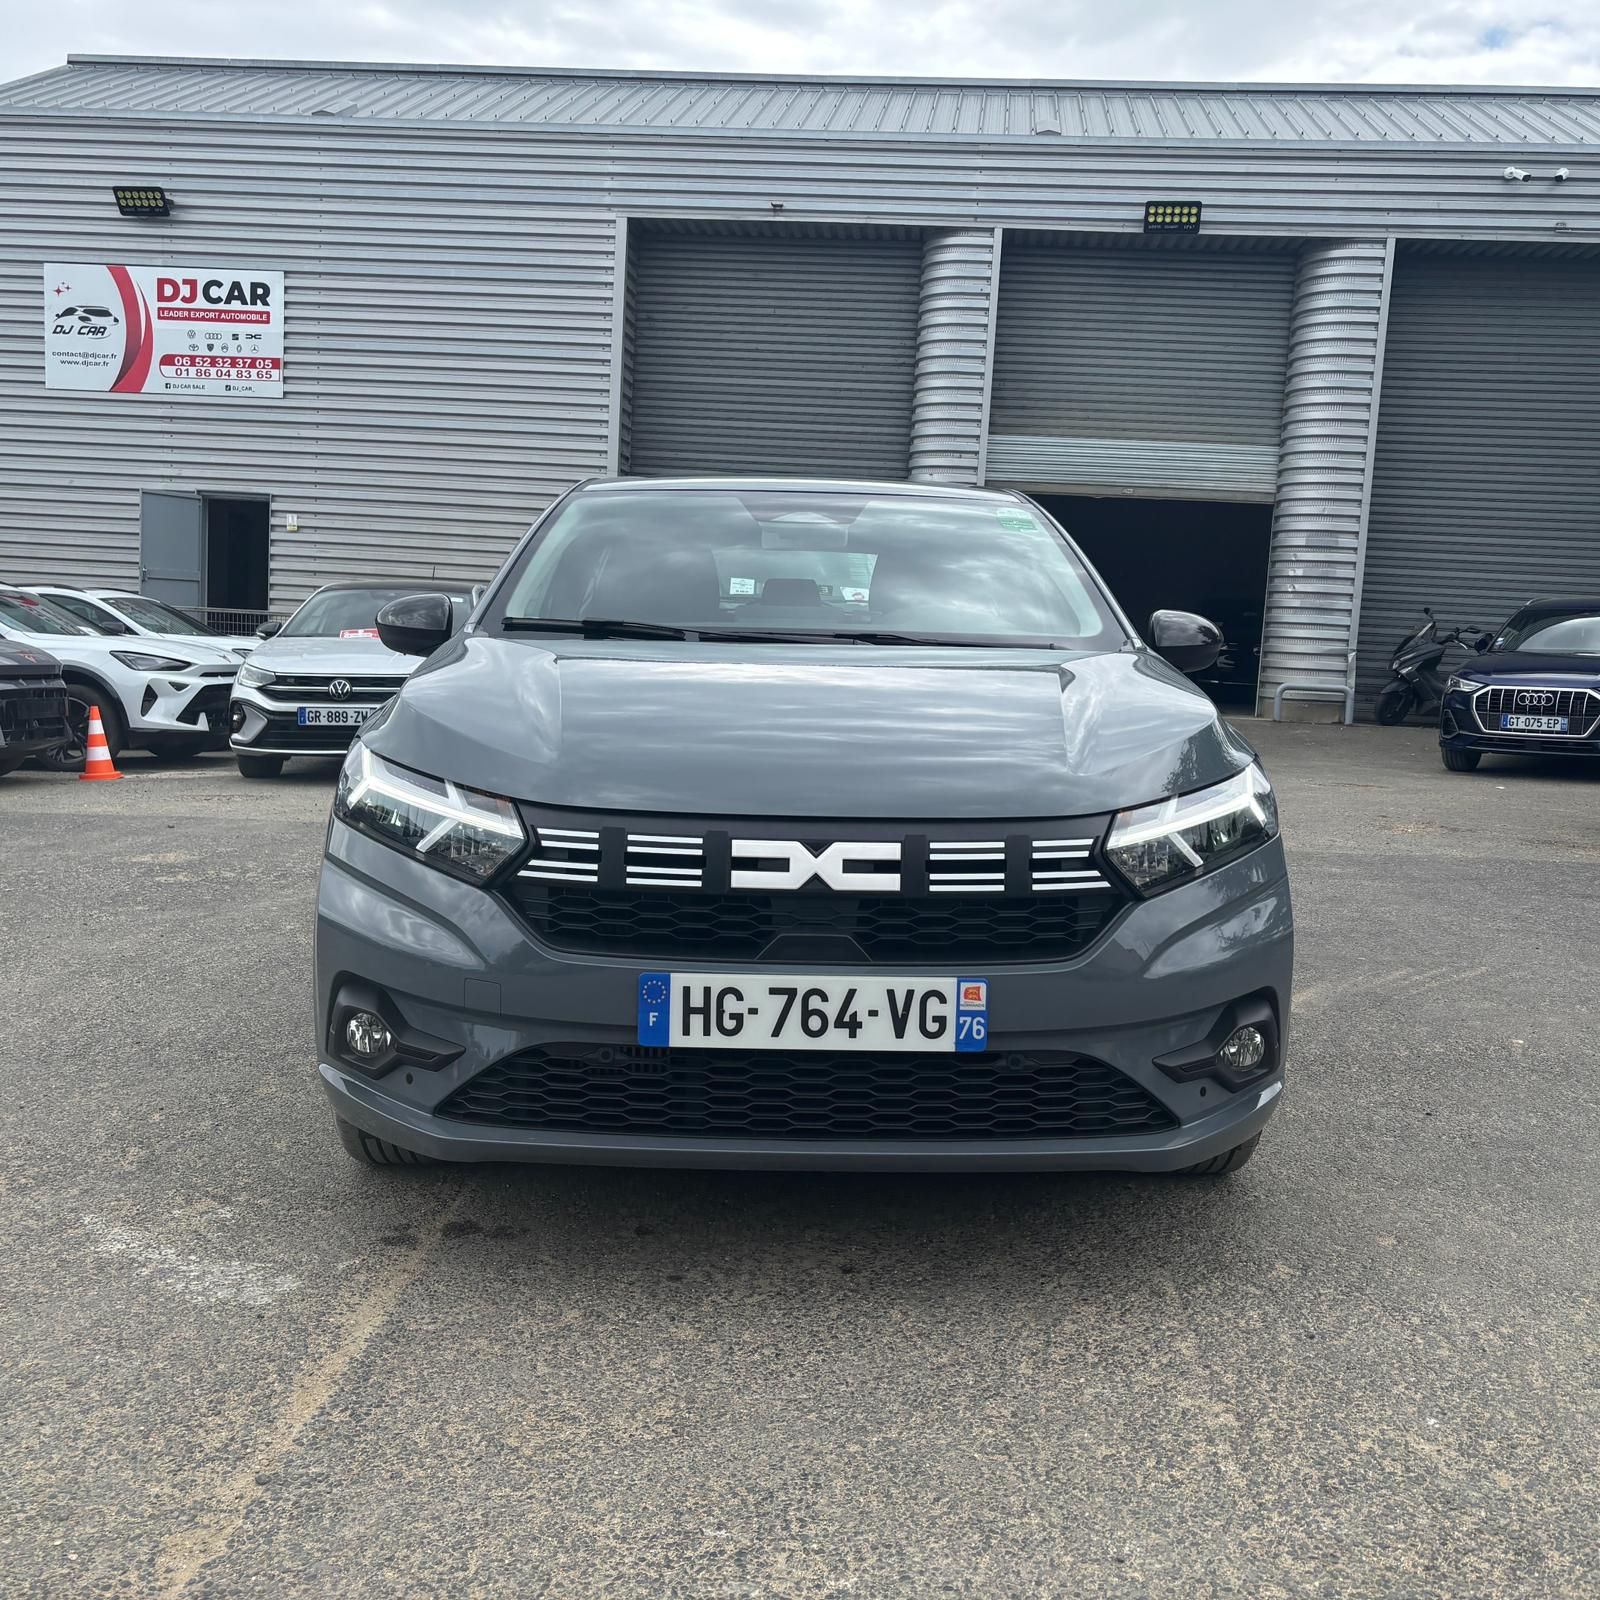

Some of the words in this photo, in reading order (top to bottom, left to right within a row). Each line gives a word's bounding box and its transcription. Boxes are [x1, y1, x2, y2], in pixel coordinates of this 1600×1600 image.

[157, 278, 198, 304] DJ
[202, 279, 271, 306] CAR
[160, 310, 189, 318] LEADER
[190, 311, 219, 319] EXPORT
[220, 312, 268, 321] AUTOMOBILE
[52, 324, 75, 335] DJ
[52, 351, 117, 360] contact@djcar.fr
[59, 359, 110, 368] www.djcar.fr
[174, 357, 191, 366] 06
[195, 357, 211, 367] 52
[215, 358, 231, 368] 32
[236, 358, 251, 368] 37
[256, 359, 272, 369] 05
[175, 368, 190, 377] 01
[195, 368, 211, 377] 86
[215, 369, 231, 378] 04
[236, 369, 252, 379] 83
[256, 370, 272, 379] 65
[1508, 716, 1560, 729] GT-075-EP
[682, 985, 948, 1039] HG-764-VG
[649, 1012, 659, 1026] F
[959, 1017, 985, 1040] 76
